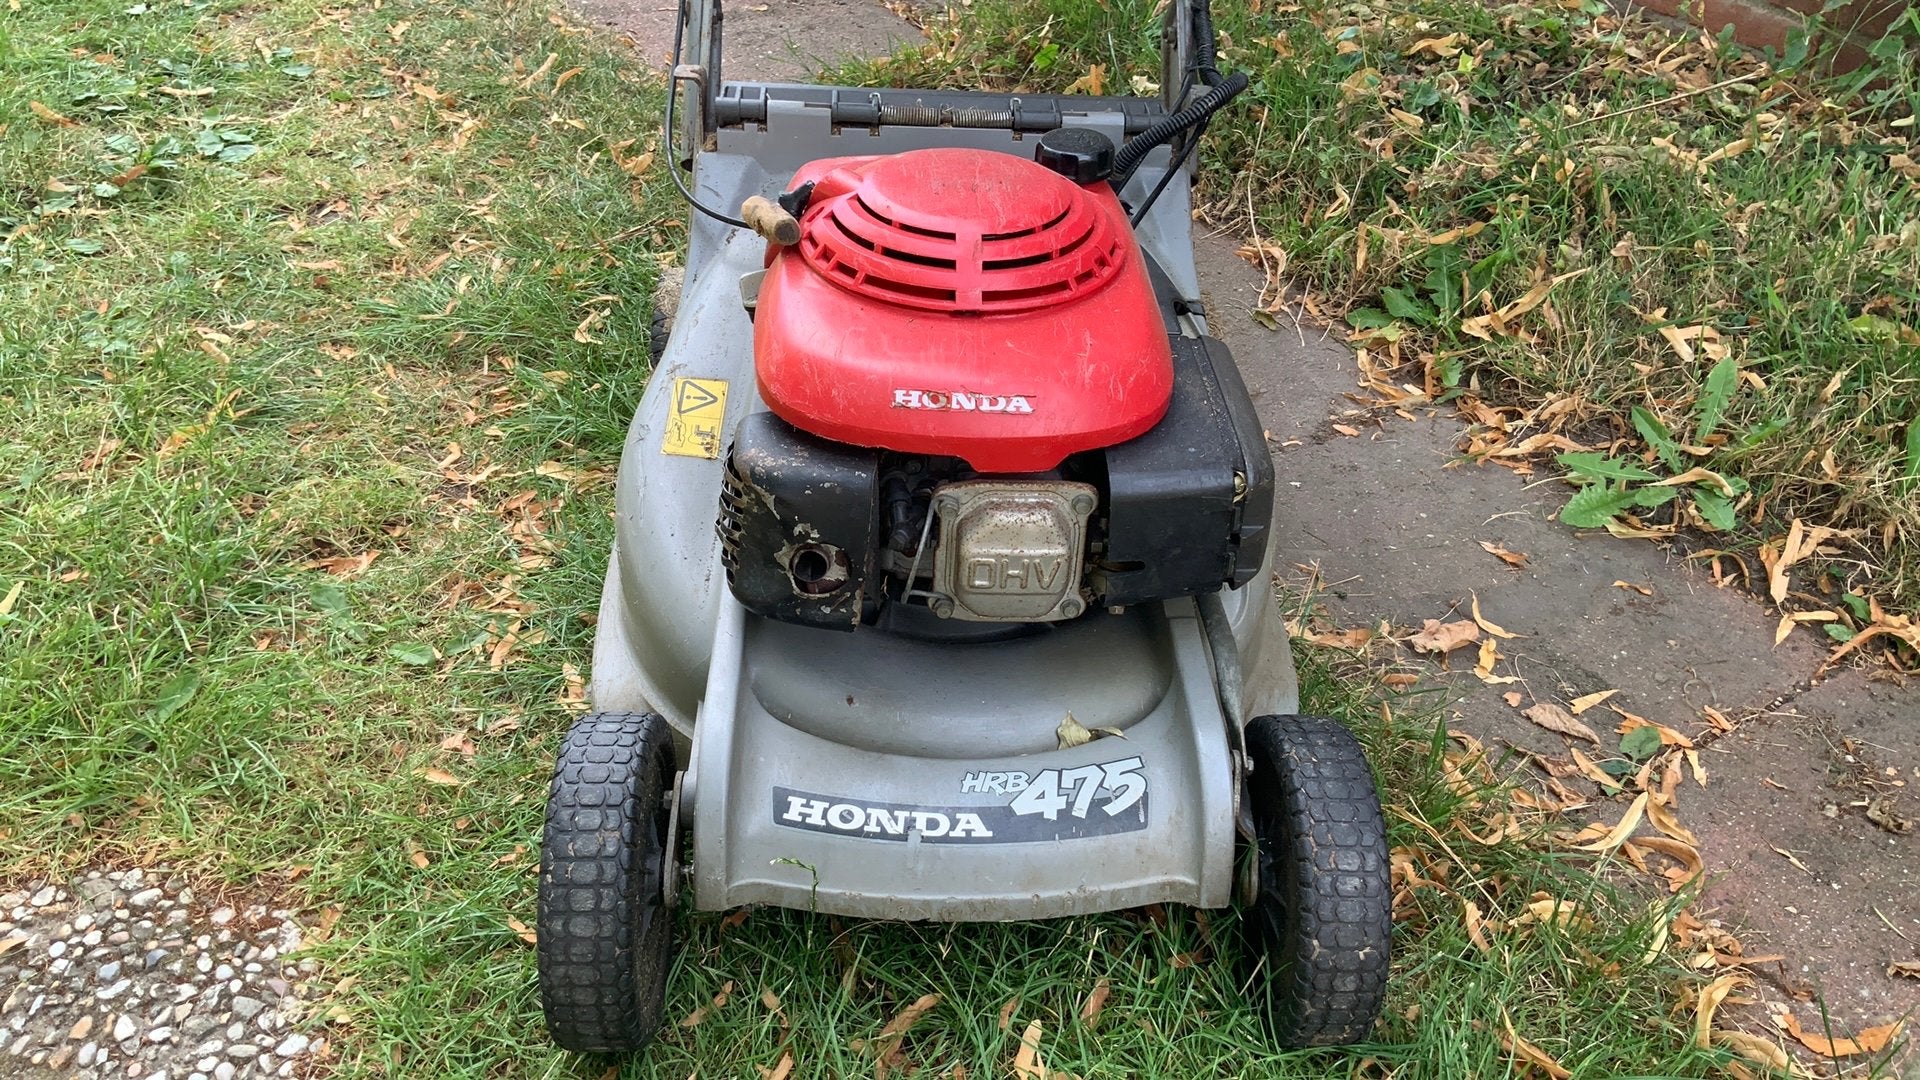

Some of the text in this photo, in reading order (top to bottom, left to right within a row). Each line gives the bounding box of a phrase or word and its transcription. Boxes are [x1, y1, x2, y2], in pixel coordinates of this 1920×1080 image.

[893, 389, 1034, 414] HONDA
[967, 558, 1062, 589] OHV
[960, 756, 1149, 821] HRB 475
[782, 795, 993, 838] HONDA
